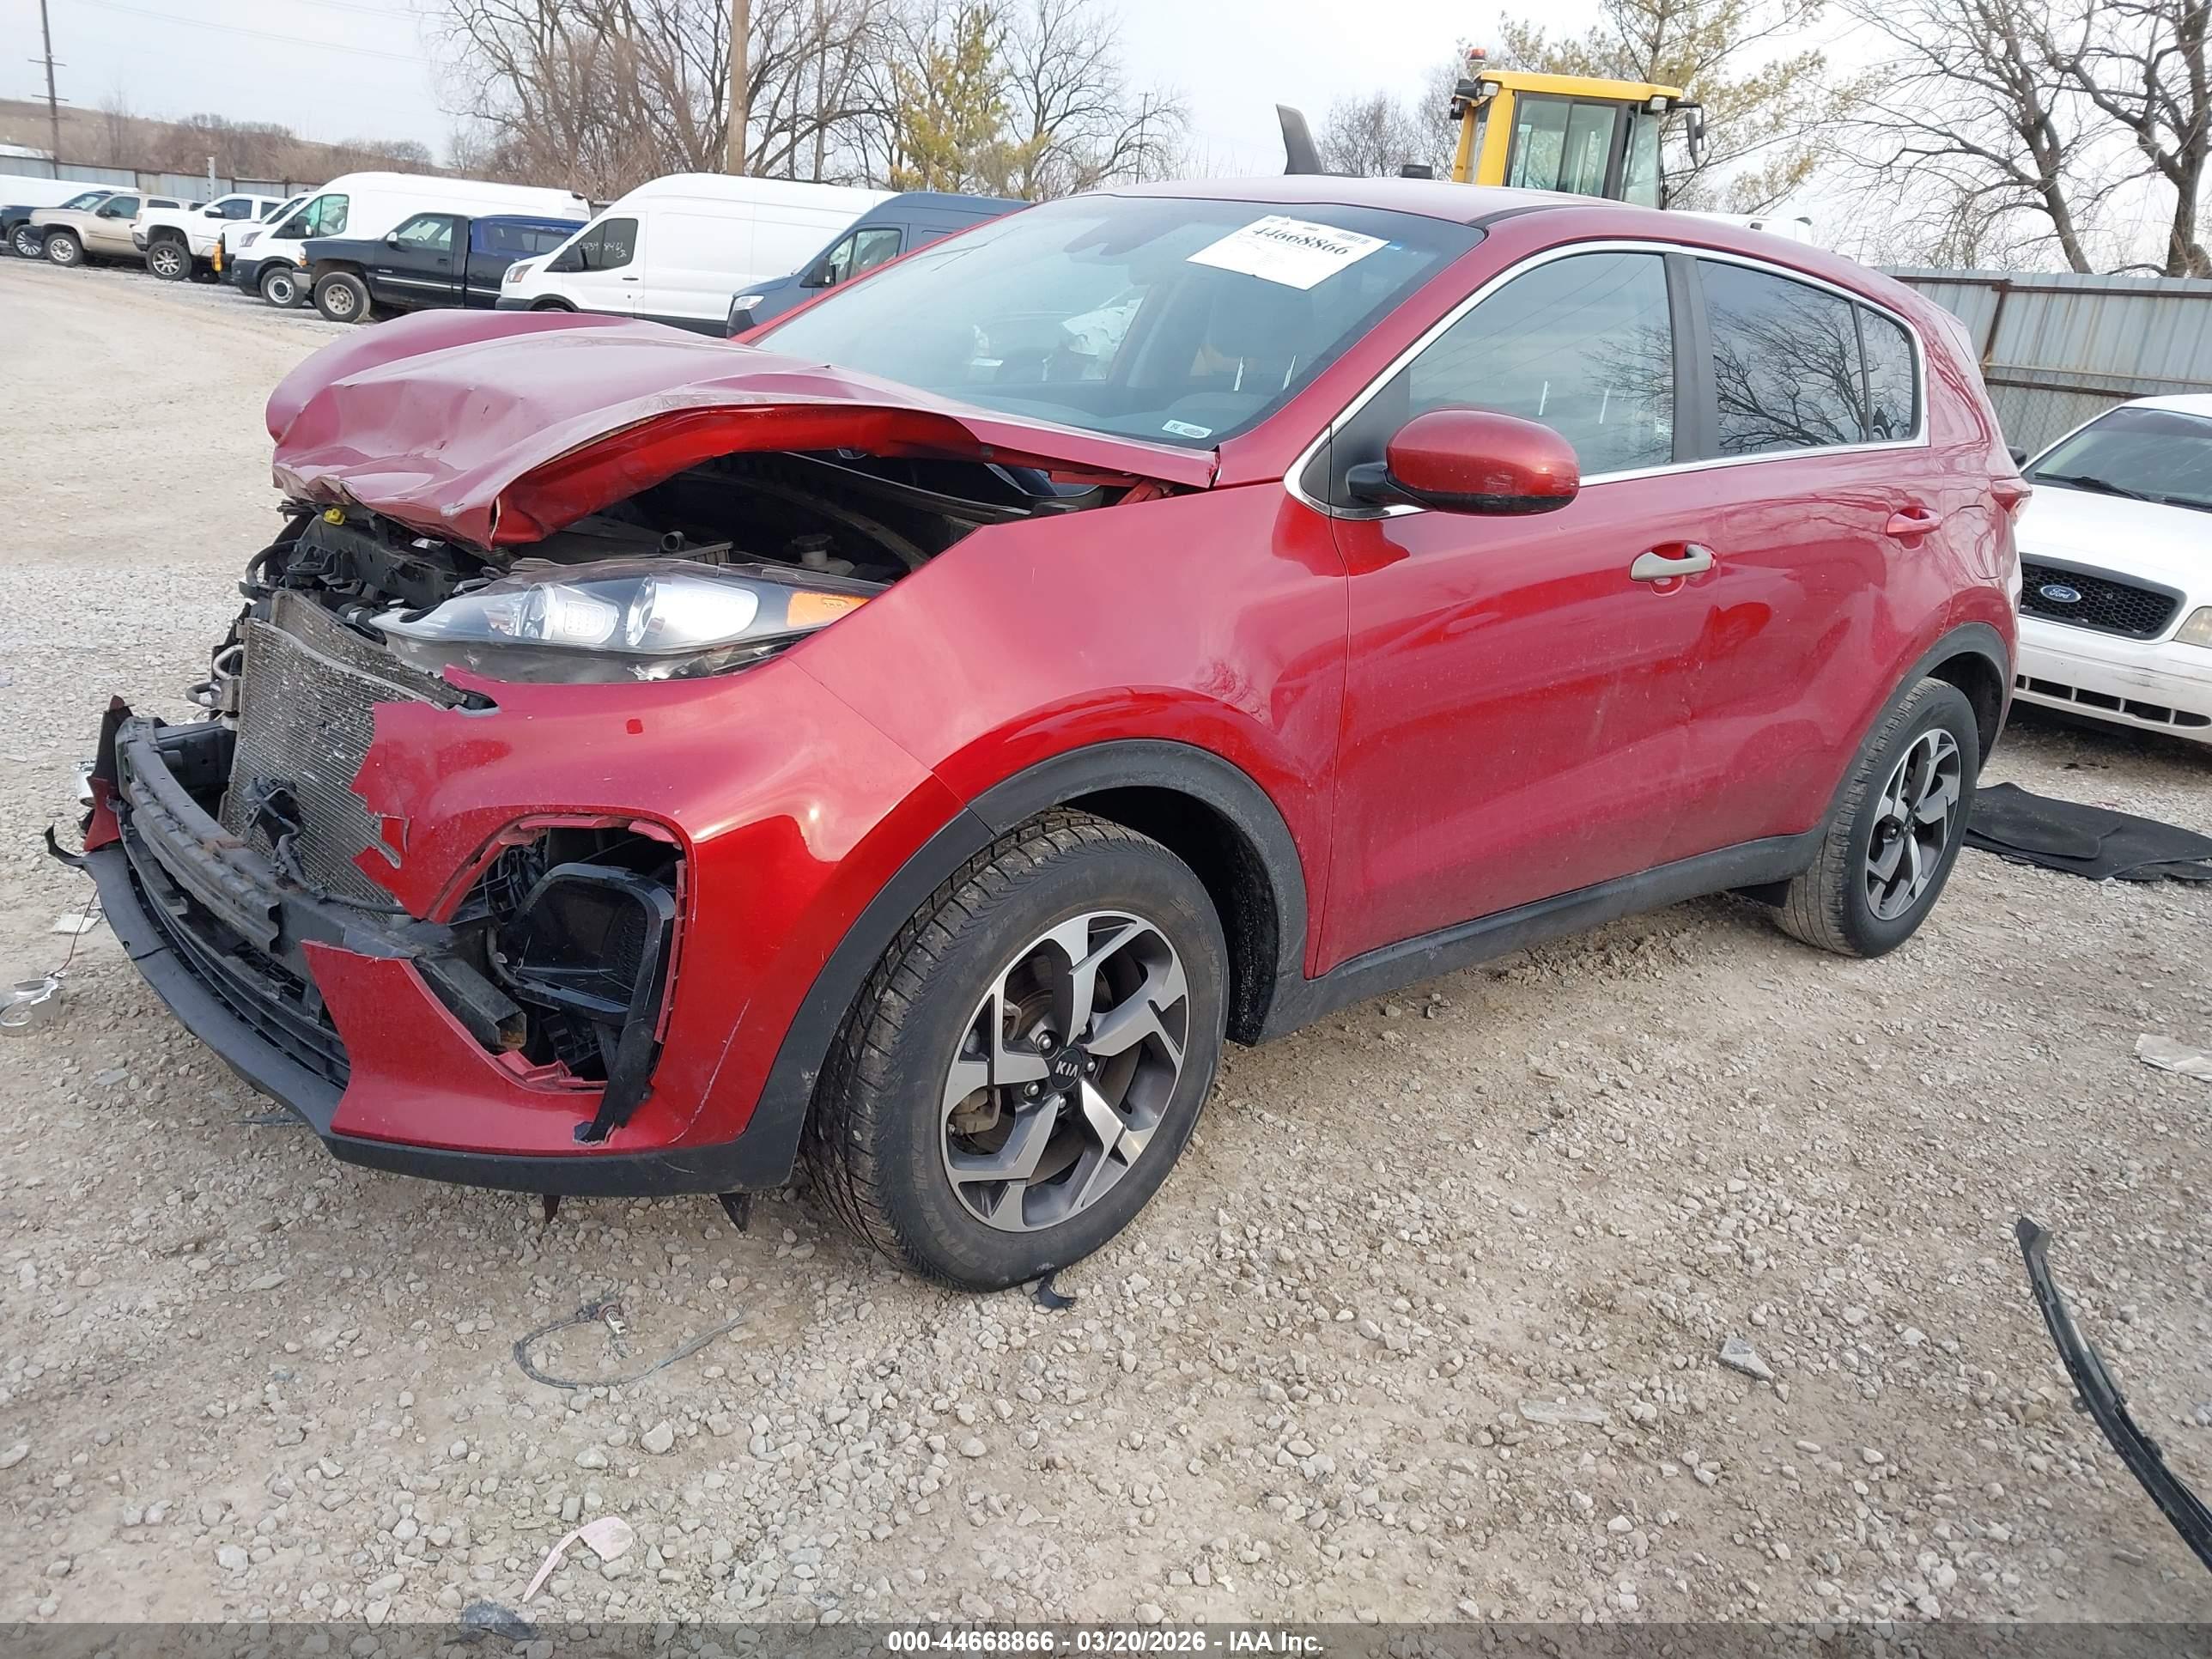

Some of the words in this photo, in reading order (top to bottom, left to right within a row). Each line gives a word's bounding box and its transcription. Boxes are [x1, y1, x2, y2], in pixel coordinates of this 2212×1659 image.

[1253, 227, 1352, 256] 44668866
[2050, 587, 2071, 599] Ford
[1055, 1060, 1079, 1078] KIA
